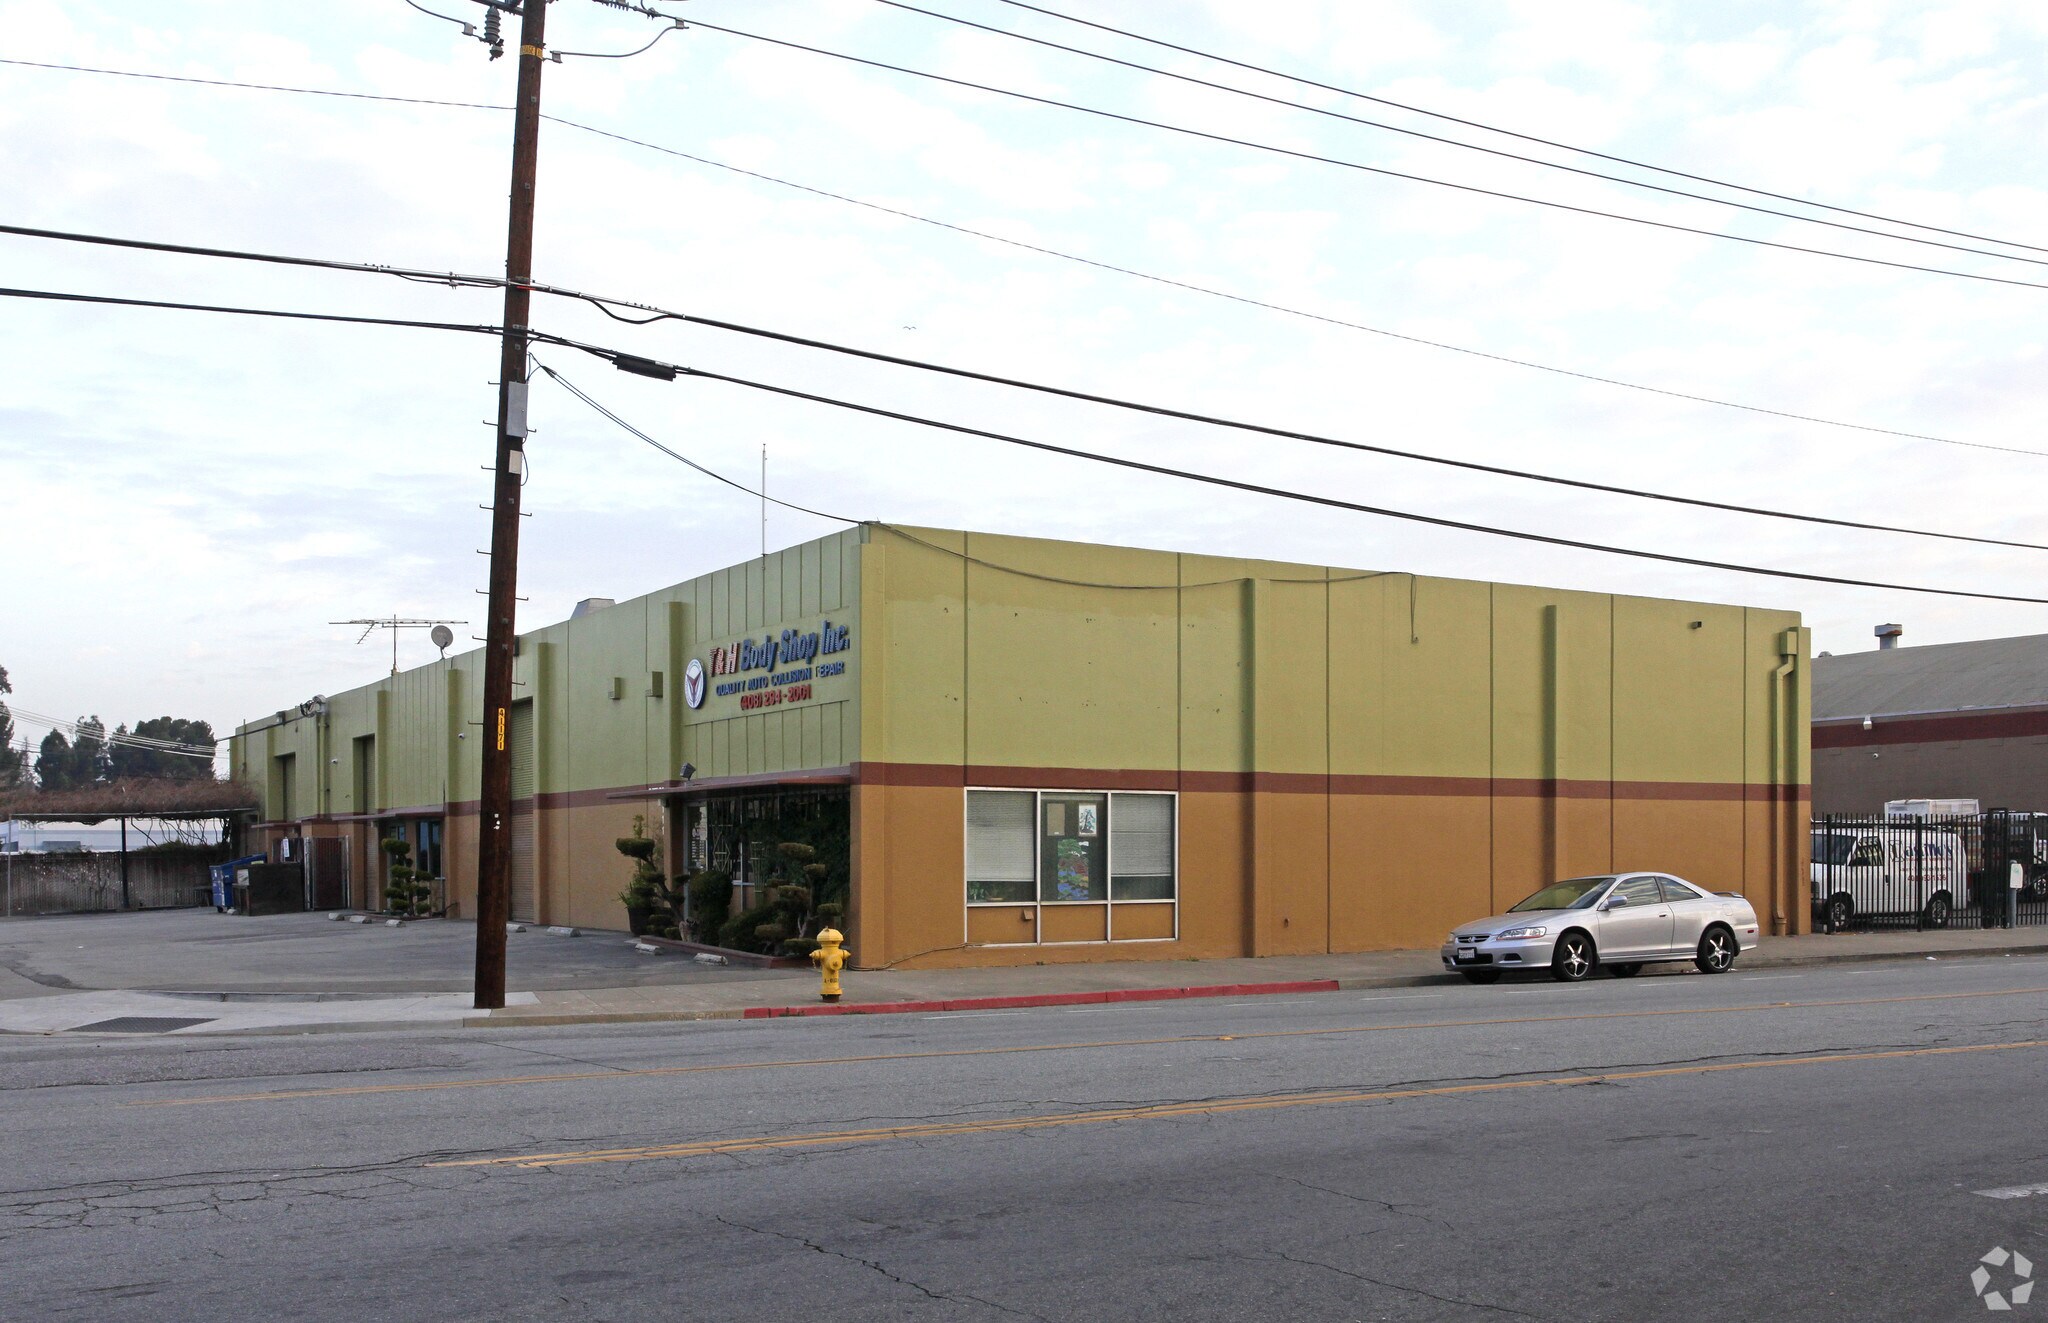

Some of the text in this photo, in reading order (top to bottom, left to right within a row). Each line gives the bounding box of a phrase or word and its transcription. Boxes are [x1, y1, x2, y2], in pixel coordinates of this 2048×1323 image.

[741, 635, 779, 672] Body
[779, 629, 818, 664] Shop
[821, 619, 850, 655] Inc.
[716, 680, 746, 696] QUALITY
[748, 675, 768, 691] AUTO
[771, 667, 811, 686] COLLISION
[740, 692, 763, 710] (408)
